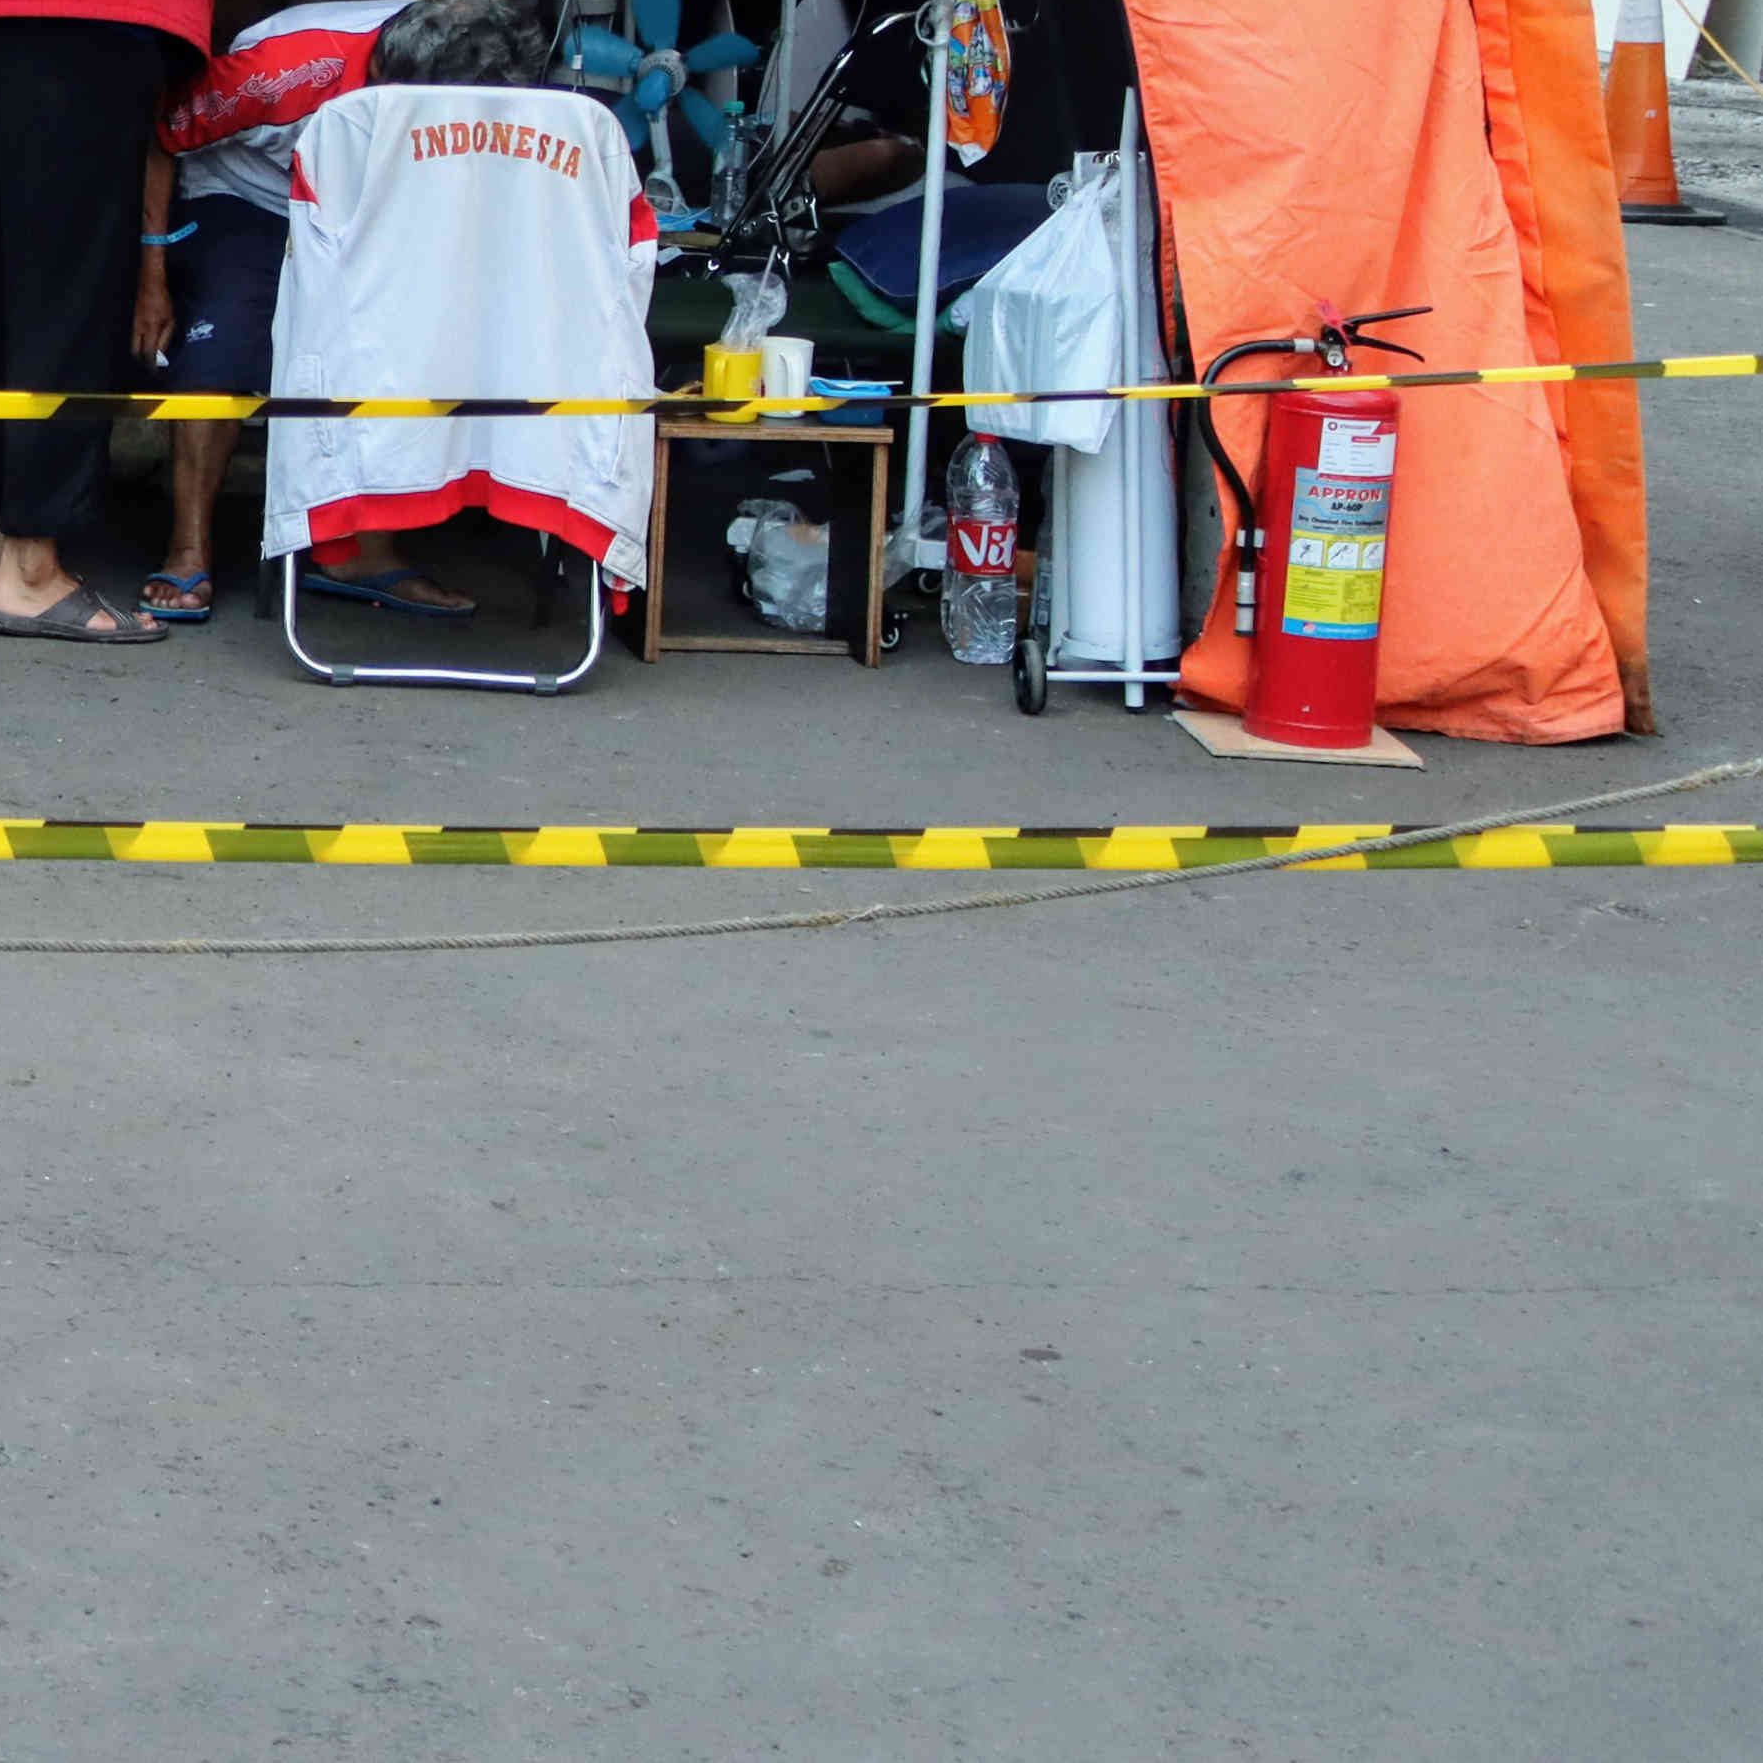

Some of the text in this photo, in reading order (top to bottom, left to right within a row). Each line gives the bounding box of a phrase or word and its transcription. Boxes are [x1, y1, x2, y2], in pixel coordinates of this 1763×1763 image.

[410, 120, 582, 181] INDONESIA
[1307, 484, 1382, 503] APPRON
[958, 524, 1015, 569] Vit
